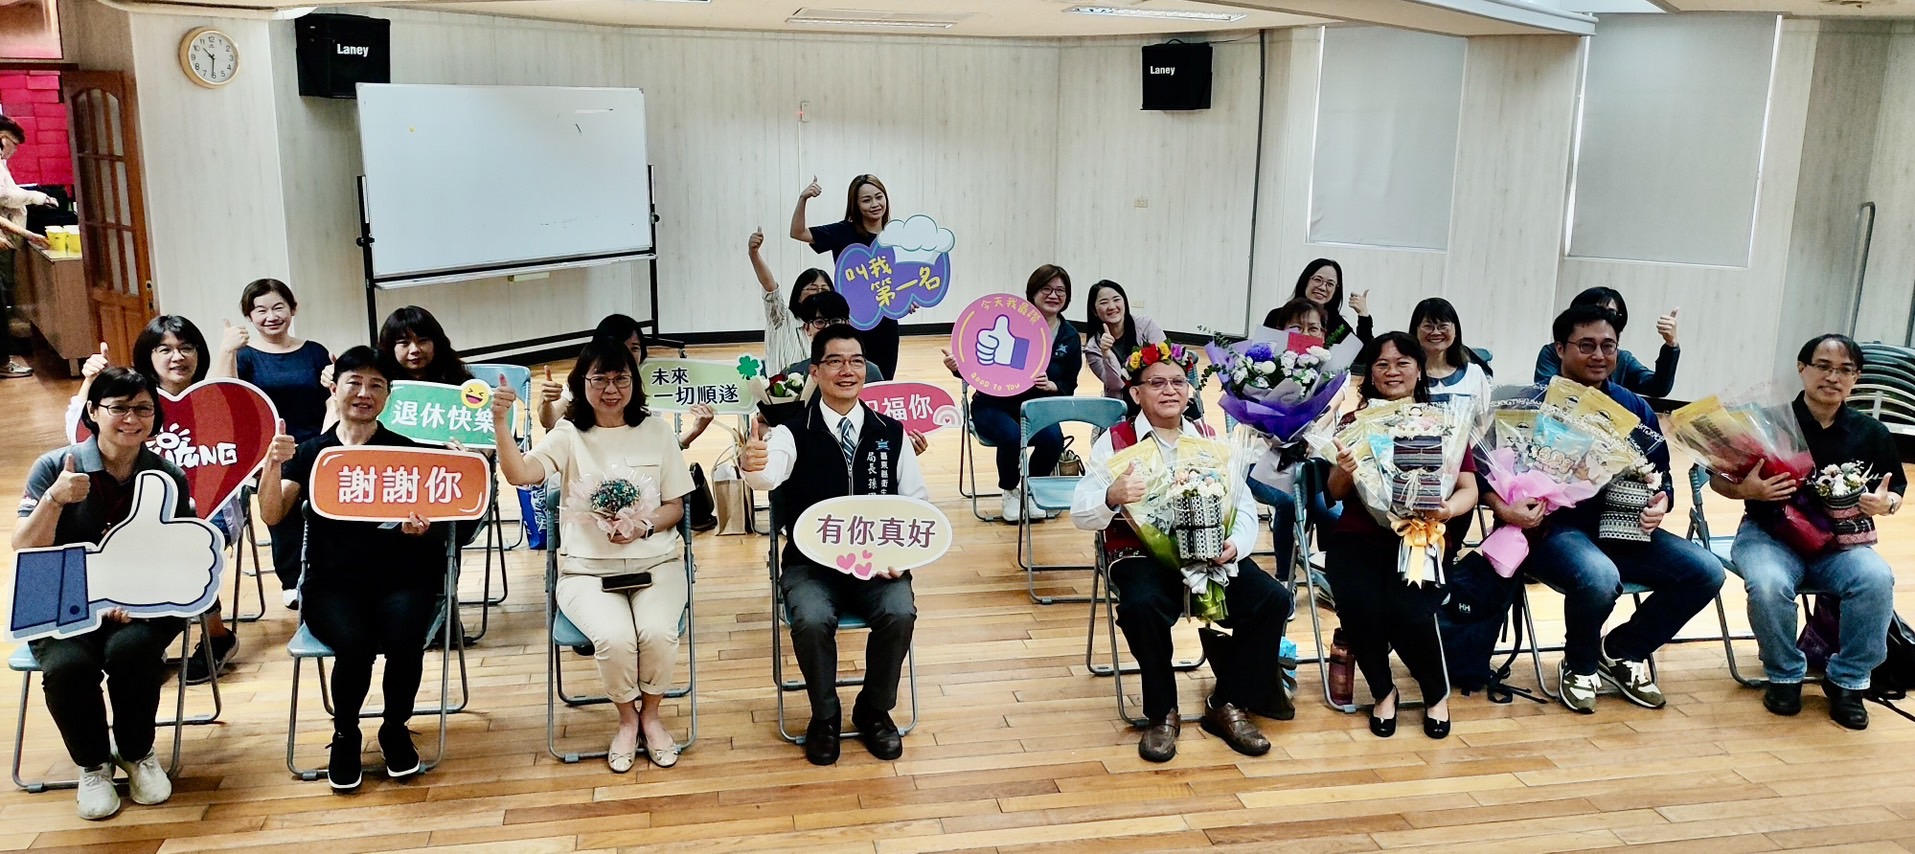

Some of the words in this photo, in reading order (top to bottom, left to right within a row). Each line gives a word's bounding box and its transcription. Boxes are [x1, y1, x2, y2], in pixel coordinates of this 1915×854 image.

[336, 43, 369, 57] Laney
[1150, 65, 1176, 76] Laney
[845, 256, 892, 281] 叫我
[871, 277, 941, 306] 第一名
[652, 367, 689, 385] 未來
[654, 384, 739, 405] 一切順遂
[864, 394, 933, 420] 福你
[391, 400, 495, 433] 退休快樂
[338, 465, 463, 504] 謝謝你
[866, 452, 877, 495] 局長孫
[816, 514, 936, 549] 有你真好
